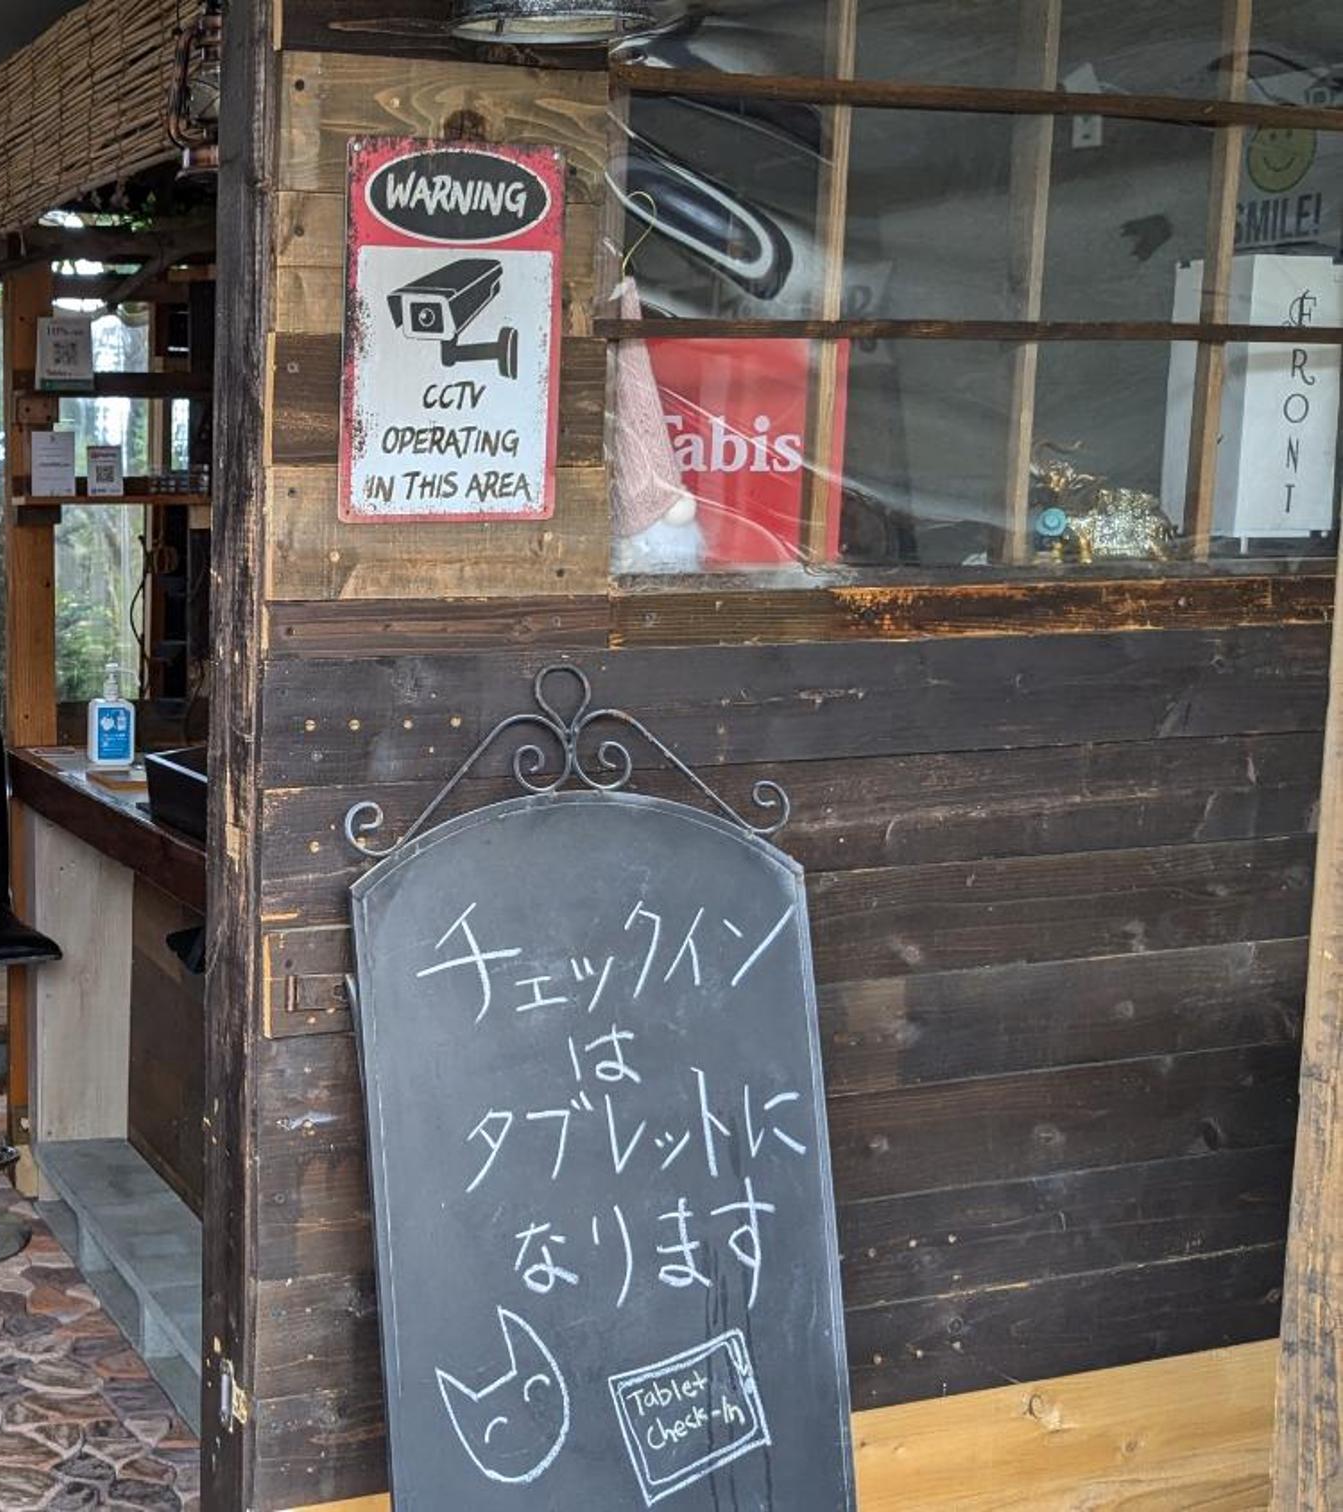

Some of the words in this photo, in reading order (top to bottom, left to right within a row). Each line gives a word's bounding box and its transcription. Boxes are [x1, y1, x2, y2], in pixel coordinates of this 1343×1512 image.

[385, 171, 526, 218] WARNING
[422, 381, 487, 410] CCTV
[1282, 289, 1316, 513] FRONT
[381, 425, 520, 460] OPERATING
[365, 473, 395, 502] IN
[403, 471, 457, 500] THIS
[465, 471, 532, 502] AREA
[416, 900, 797, 1024] チェックイン
[567, 1023, 642, 1083] は
[466, 1066, 806, 1192] タブレットに
[513, 1175, 776, 1309] なります
[626, 1370, 708, 1416] Tablet
